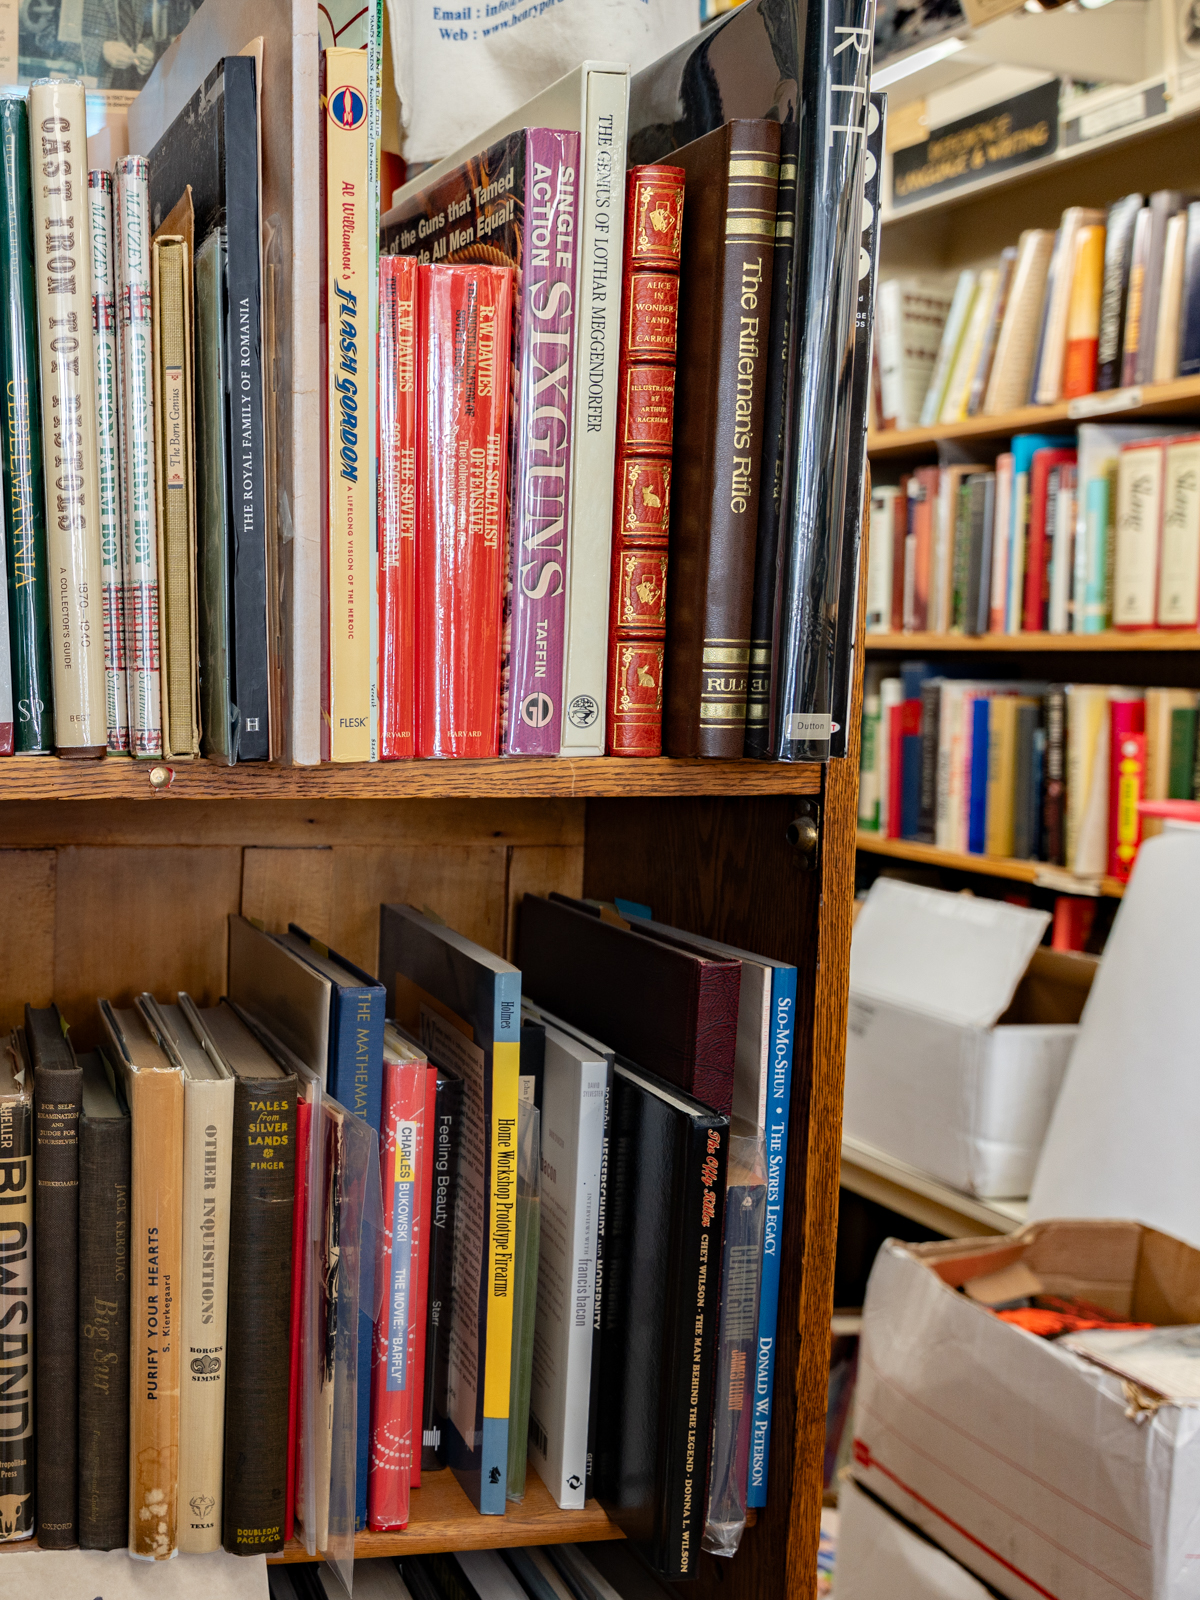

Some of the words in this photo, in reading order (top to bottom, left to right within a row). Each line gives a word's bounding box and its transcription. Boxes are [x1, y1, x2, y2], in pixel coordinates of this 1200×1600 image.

[433, 6, 471, 20] Email
[439, 28, 468, 41] Web
[42, 117, 73, 201] CAST
[596, 150, 612, 208] GENIUS
[418, 212, 445, 240] Guns
[448, 194, 471, 222] that
[474, 167, 514, 205] Tamed
[532, 162, 552, 266] ACTION
[556, 166, 574, 268] SINGLE
[8, 210, 19, 275] MACHADO
[45, 216, 76, 295] IRON
[92, 202, 108, 286] MAUZEY
[125, 189, 142, 274] MAUZEY
[341, 202, 356, 280] Williamson's
[432, 238, 446, 262] All
[450, 227, 474, 252] Men
[476, 199, 514, 238] Equal!
[592, 238, 608, 301] LOTHAR
[741, 257, 762, 310] The
[239, 298, 251, 367] ROMANIA
[334, 278, 358, 376] FLASH
[636, 304, 676, 312] WONDER-
[646, 316, 670, 324] LAND
[48, 312, 79, 376] TOY
[636, 334, 674, 344] CARROLL
[240, 371, 251, 391] OF
[400, 340, 413, 392] DAVIES
[478, 340, 493, 397] DAVIES
[587, 306, 606, 433] MEGGENDORFER
[733, 317, 759, 449] Rifleman's
[170, 420, 180, 445] Born
[240, 394, 252, 448] FAMILY
[334, 374, 358, 483] GORDON
[520, 280, 573, 601] SIXGUNS
[52, 394, 86, 532] PISTOLS
[242, 452, 254, 500] ROYAL
[730, 456, 752, 514] Rifle
[469, 448, 486, 534] OFFENSIVE
[484, 470, 500, 549] SOCIALIST
[102, 524, 118, 570] BOY
[134, 519, 151, 568] BOY
[60, 578, 70, 640] COLLECTOR'S
[62, 642, 72, 670] GUIDE
[534, 619, 548, 678] TAFFIN
[340, 718, 366, 728] FLESK
[798, 721, 824, 730] Dutton
[500, 1001, 514, 1029] Holmes
[248, 1100, 289, 1110] TALES
[248, 1123, 288, 1132] SILVER
[258, 1112, 280, 1122] from
[204, 1125, 218, 1190] OTHER
[248, 1136, 288, 1145] LANDS
[400, 1126, 412, 1178] CHARLES
[436, 1115, 452, 1170] Feeling
[497, 1118, 515, 1146] Home
[250, 1161, 284, 1170] FINGER
[494, 1150, 514, 1199] Workshop
[434, 1176, 450, 1228] Beauty
[492, 1202, 511, 1250] Prototype
[148, 1228, 160, 1286] HEARTS
[200, 1198, 216, 1324] INQUISITIONS
[394, 1268, 406, 1290] THE
[494, 1253, 512, 1298] Firearms
[162, 1275, 172, 1336] Kierkegaard
[392, 1292, 405, 1329] MOVIE:
[697, 1265, 707, 1306] WILSON
[147, 1296, 158, 1338] YOUR
[432, 1301, 441, 1326] Starr
[694, 1314, 704, 1334] THE
[147, 1346, 158, 1400] PURIFY
[189, 1346, 223, 1354] BORGES
[692, 1338, 702, 1361] MAN
[756, 1336, 773, 1394] DONALD
[192, 1374, 220, 1382] SIMMS
[690, 1364, 700, 1405] BEHIND
[688, 1407, 698, 1428] THE
[751, 1419, 769, 1486] PETERSON
[237, 1526, 280, 1536] DOUBLEDAY
[680, 1532, 690, 1573] WILSON
